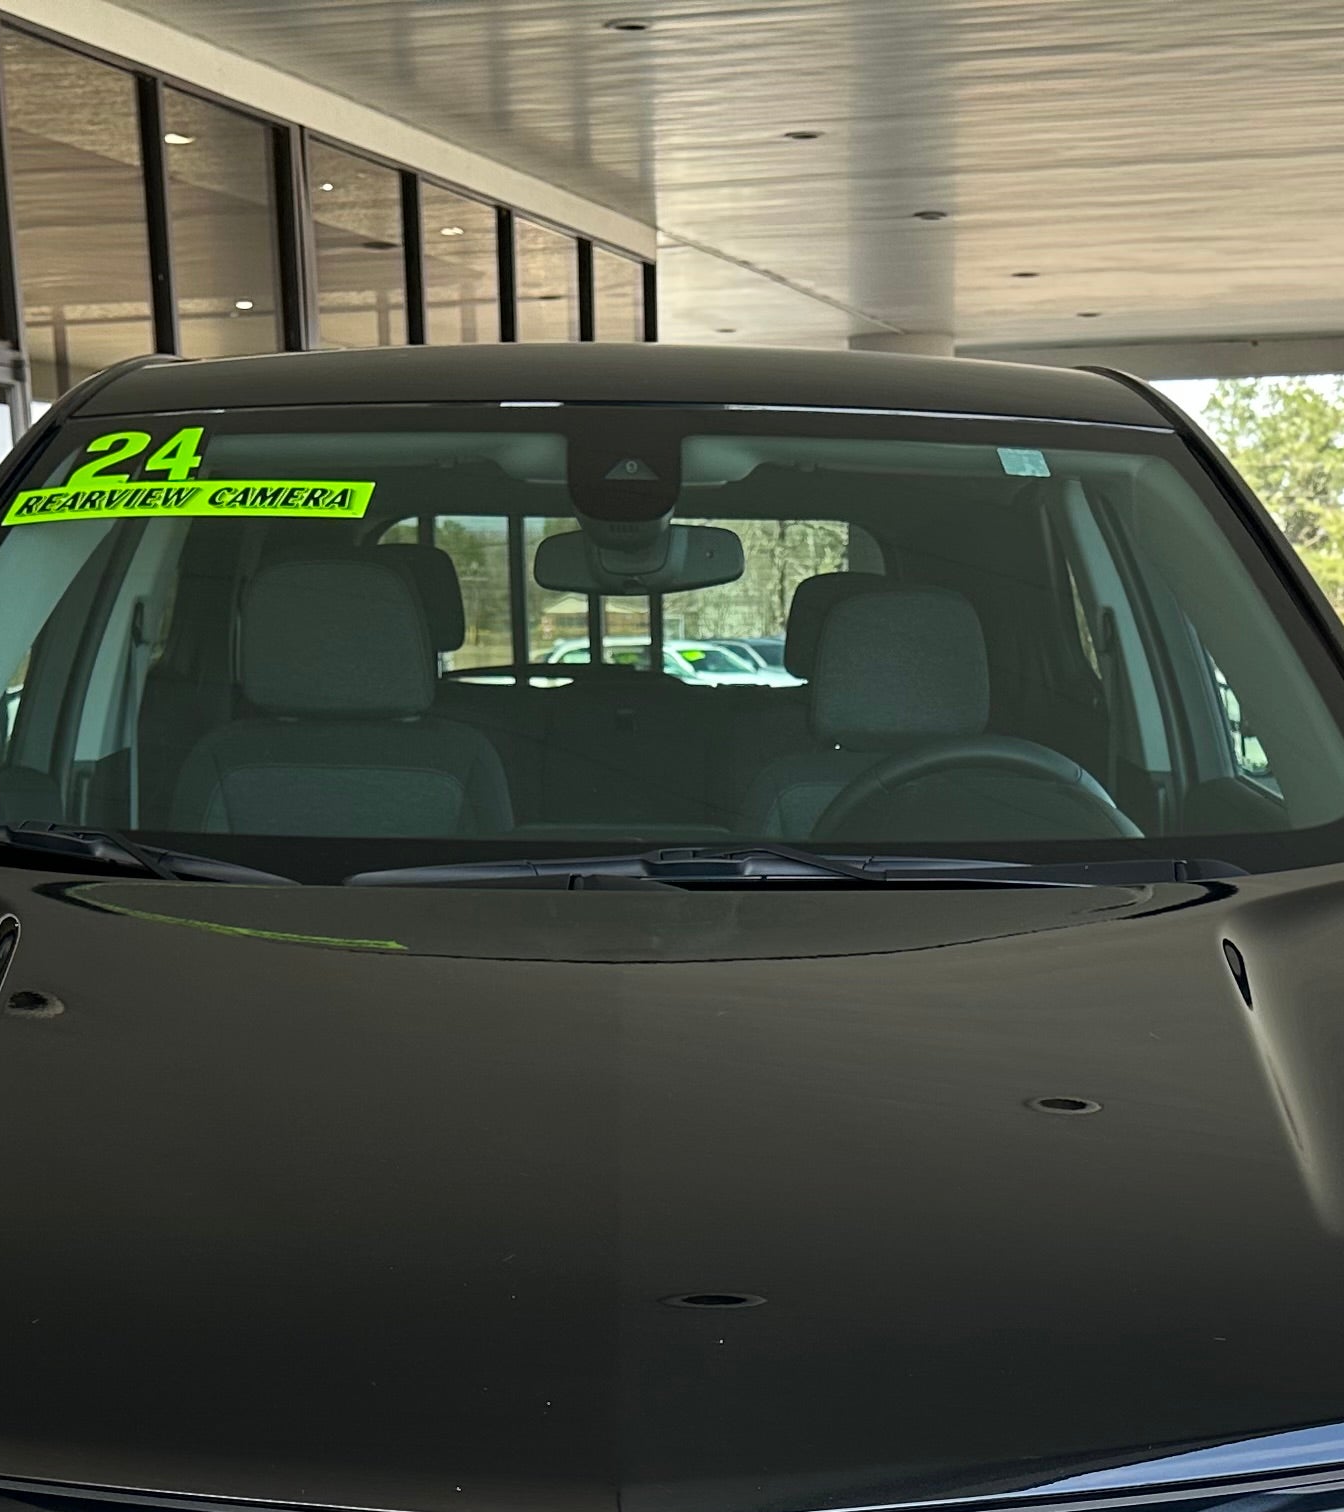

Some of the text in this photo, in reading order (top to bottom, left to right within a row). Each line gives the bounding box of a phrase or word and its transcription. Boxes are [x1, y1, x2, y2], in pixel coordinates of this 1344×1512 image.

[67, 427, 205, 486] 24
[15, 487, 352, 517] REARVIEW CAMERA
